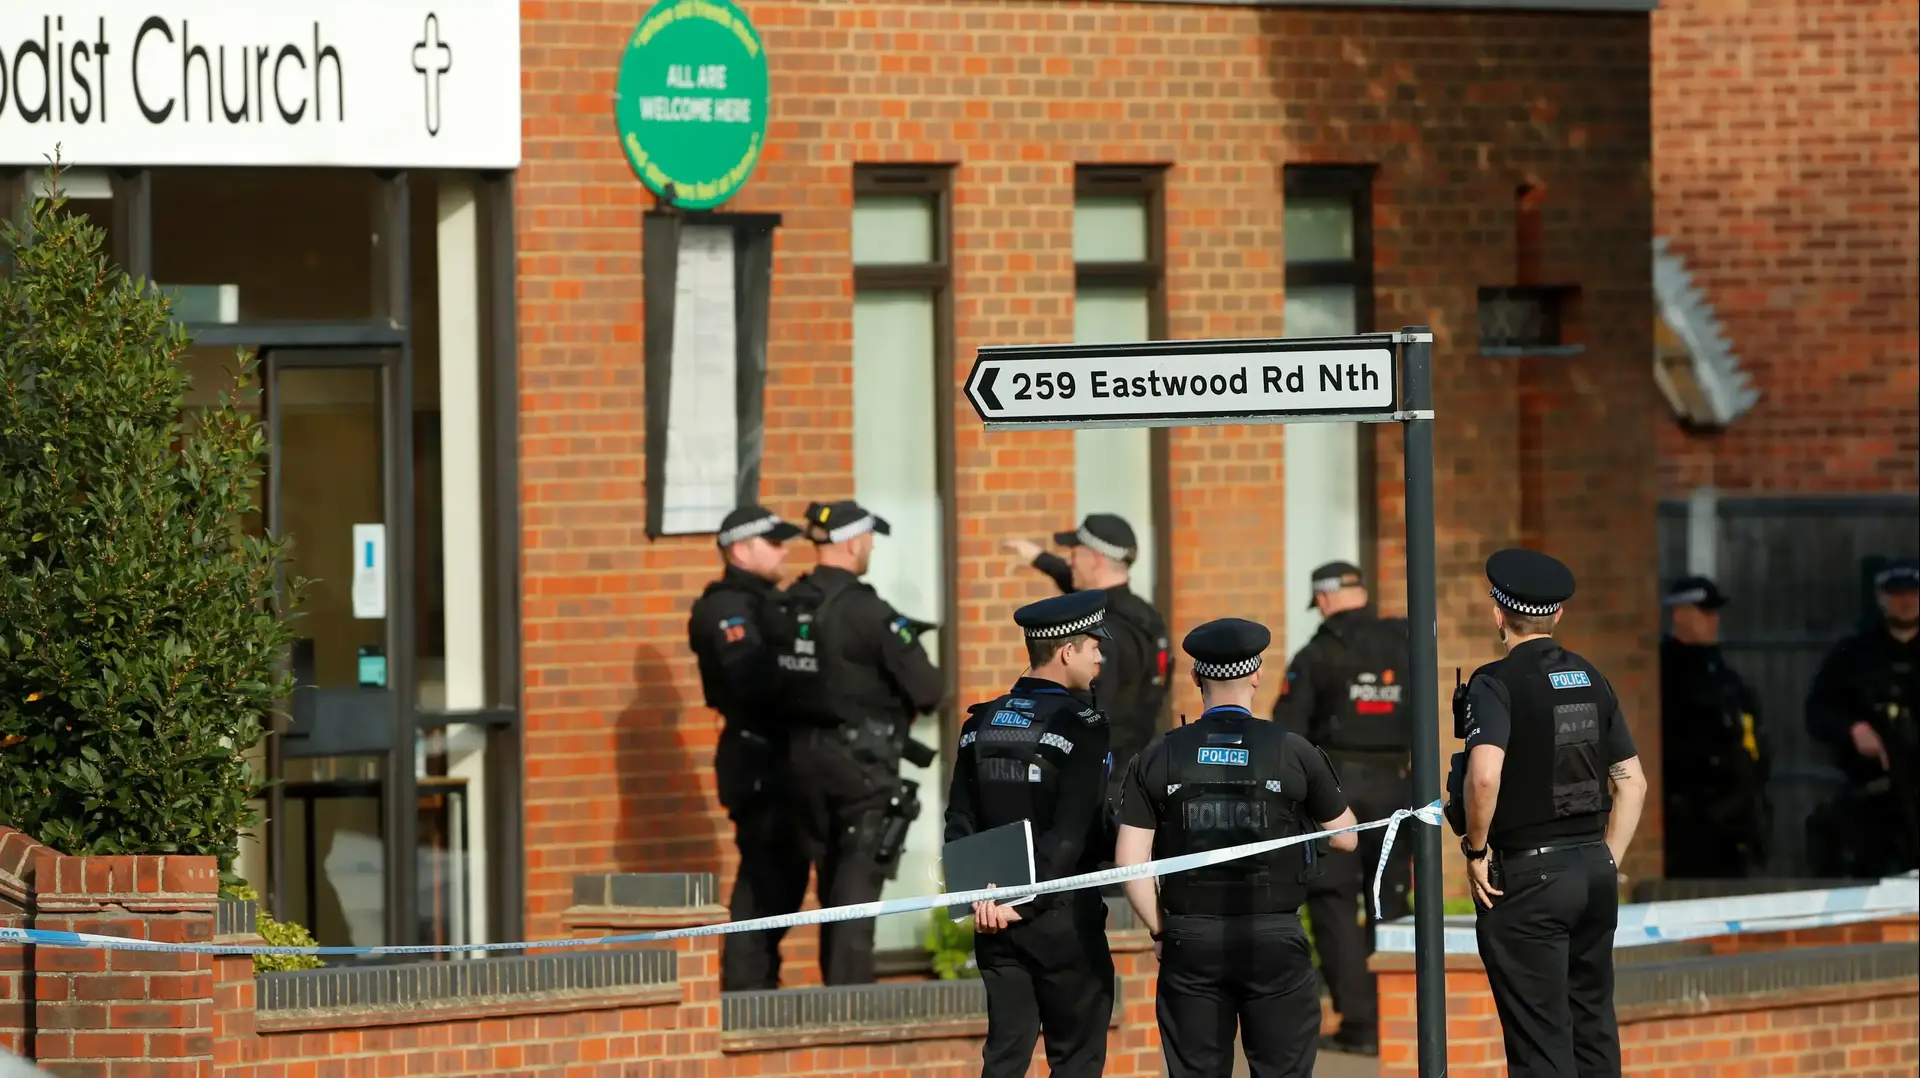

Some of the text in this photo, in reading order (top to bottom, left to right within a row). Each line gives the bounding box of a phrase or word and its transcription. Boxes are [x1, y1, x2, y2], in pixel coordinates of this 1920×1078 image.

[0, 15, 344, 125] dist Church
[666, 64, 728, 89] ALL ARE
[639, 96, 751, 123] WELCOME HERE
[1011, 362, 1380, 400] 259 Eastwood Rd Nth
[1552, 673, 1588, 686] POLICE
[1201, 749, 1245, 763] POLICE
